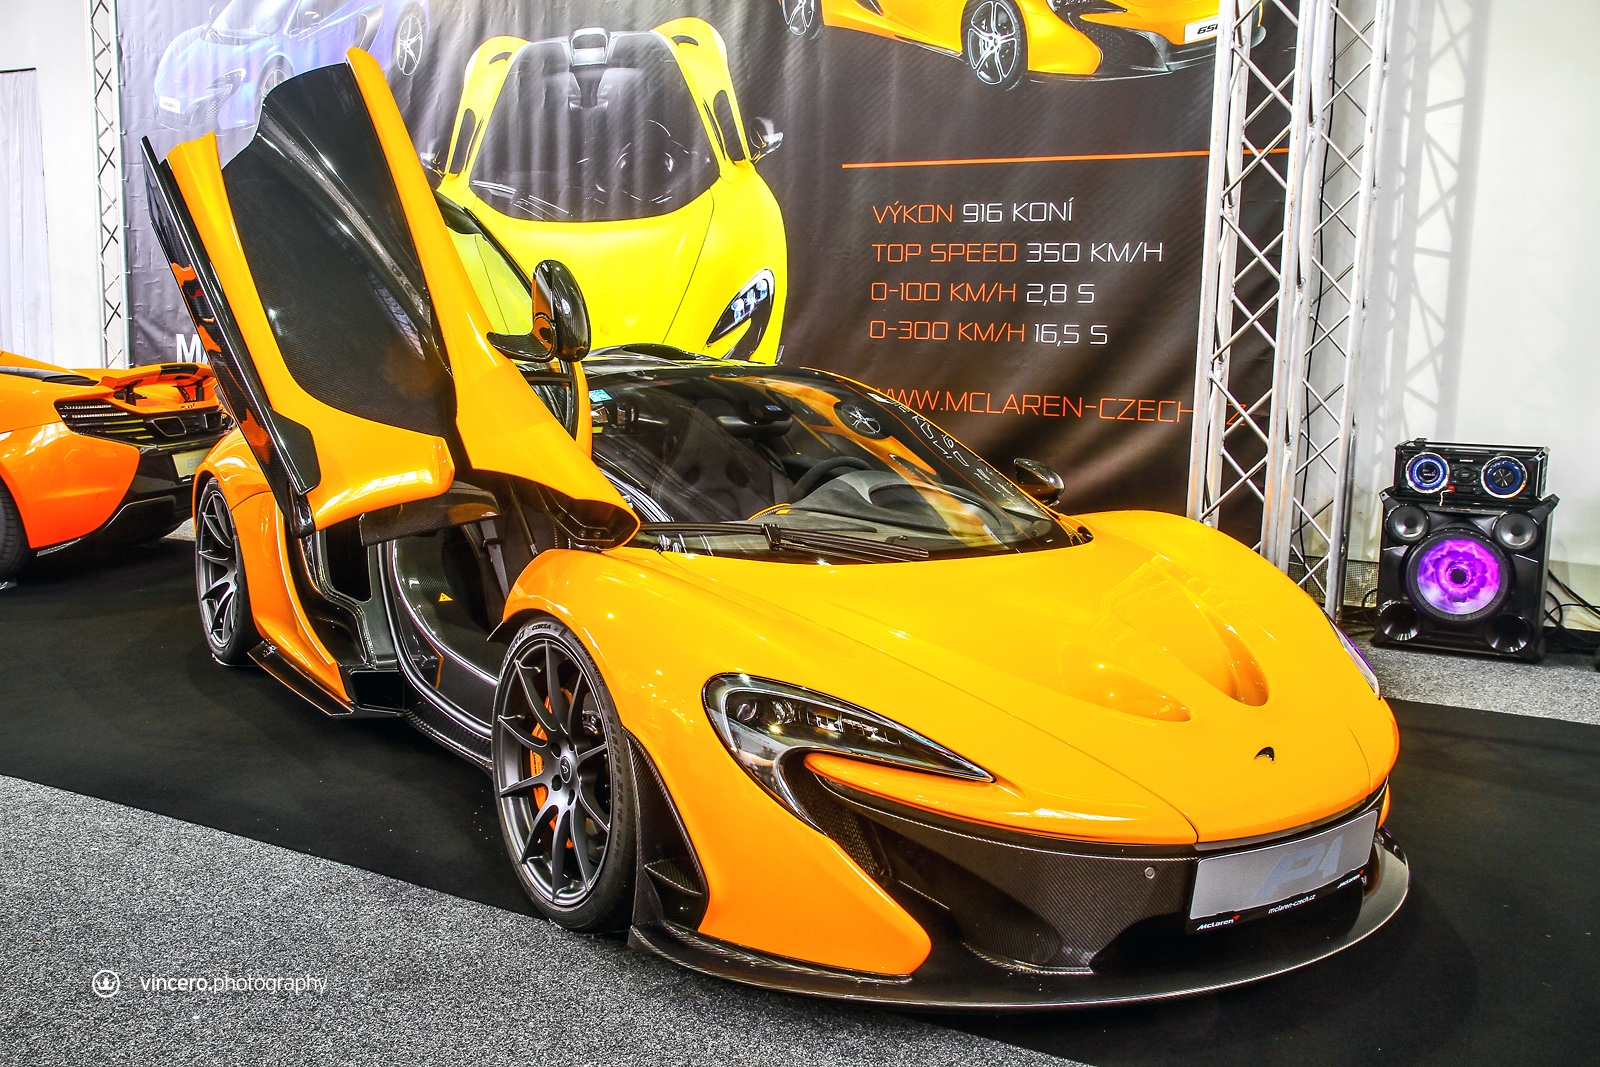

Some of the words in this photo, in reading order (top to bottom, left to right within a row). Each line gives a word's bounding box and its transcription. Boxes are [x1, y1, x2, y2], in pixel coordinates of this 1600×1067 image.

[872, 201, 953, 224] VÝKON
[962, 203, 1003, 223] 916
[1012, 197, 1075, 222] KONÍ
[872, 244, 922, 263] TOP
[930, 243, 1018, 263] SPEED
[1026, 243, 1081, 263] 350
[1090, 242, 1163, 263] KM/H
[871, 282, 941, 302] 0-100
[950, 283, 1017, 303] KM/H
[1026, 284, 1068, 307] 2,8
[1077, 284, 1095, 303] S
[869, 320, 949, 341] 0-300
[957, 322, 1026, 343] KM/H
[1034, 324, 1080, 347] 16,5
[1089, 325, 1108, 345] S
[1251, 835, 1344, 900] P1
[1196, 918, 1235, 931] McLaren
